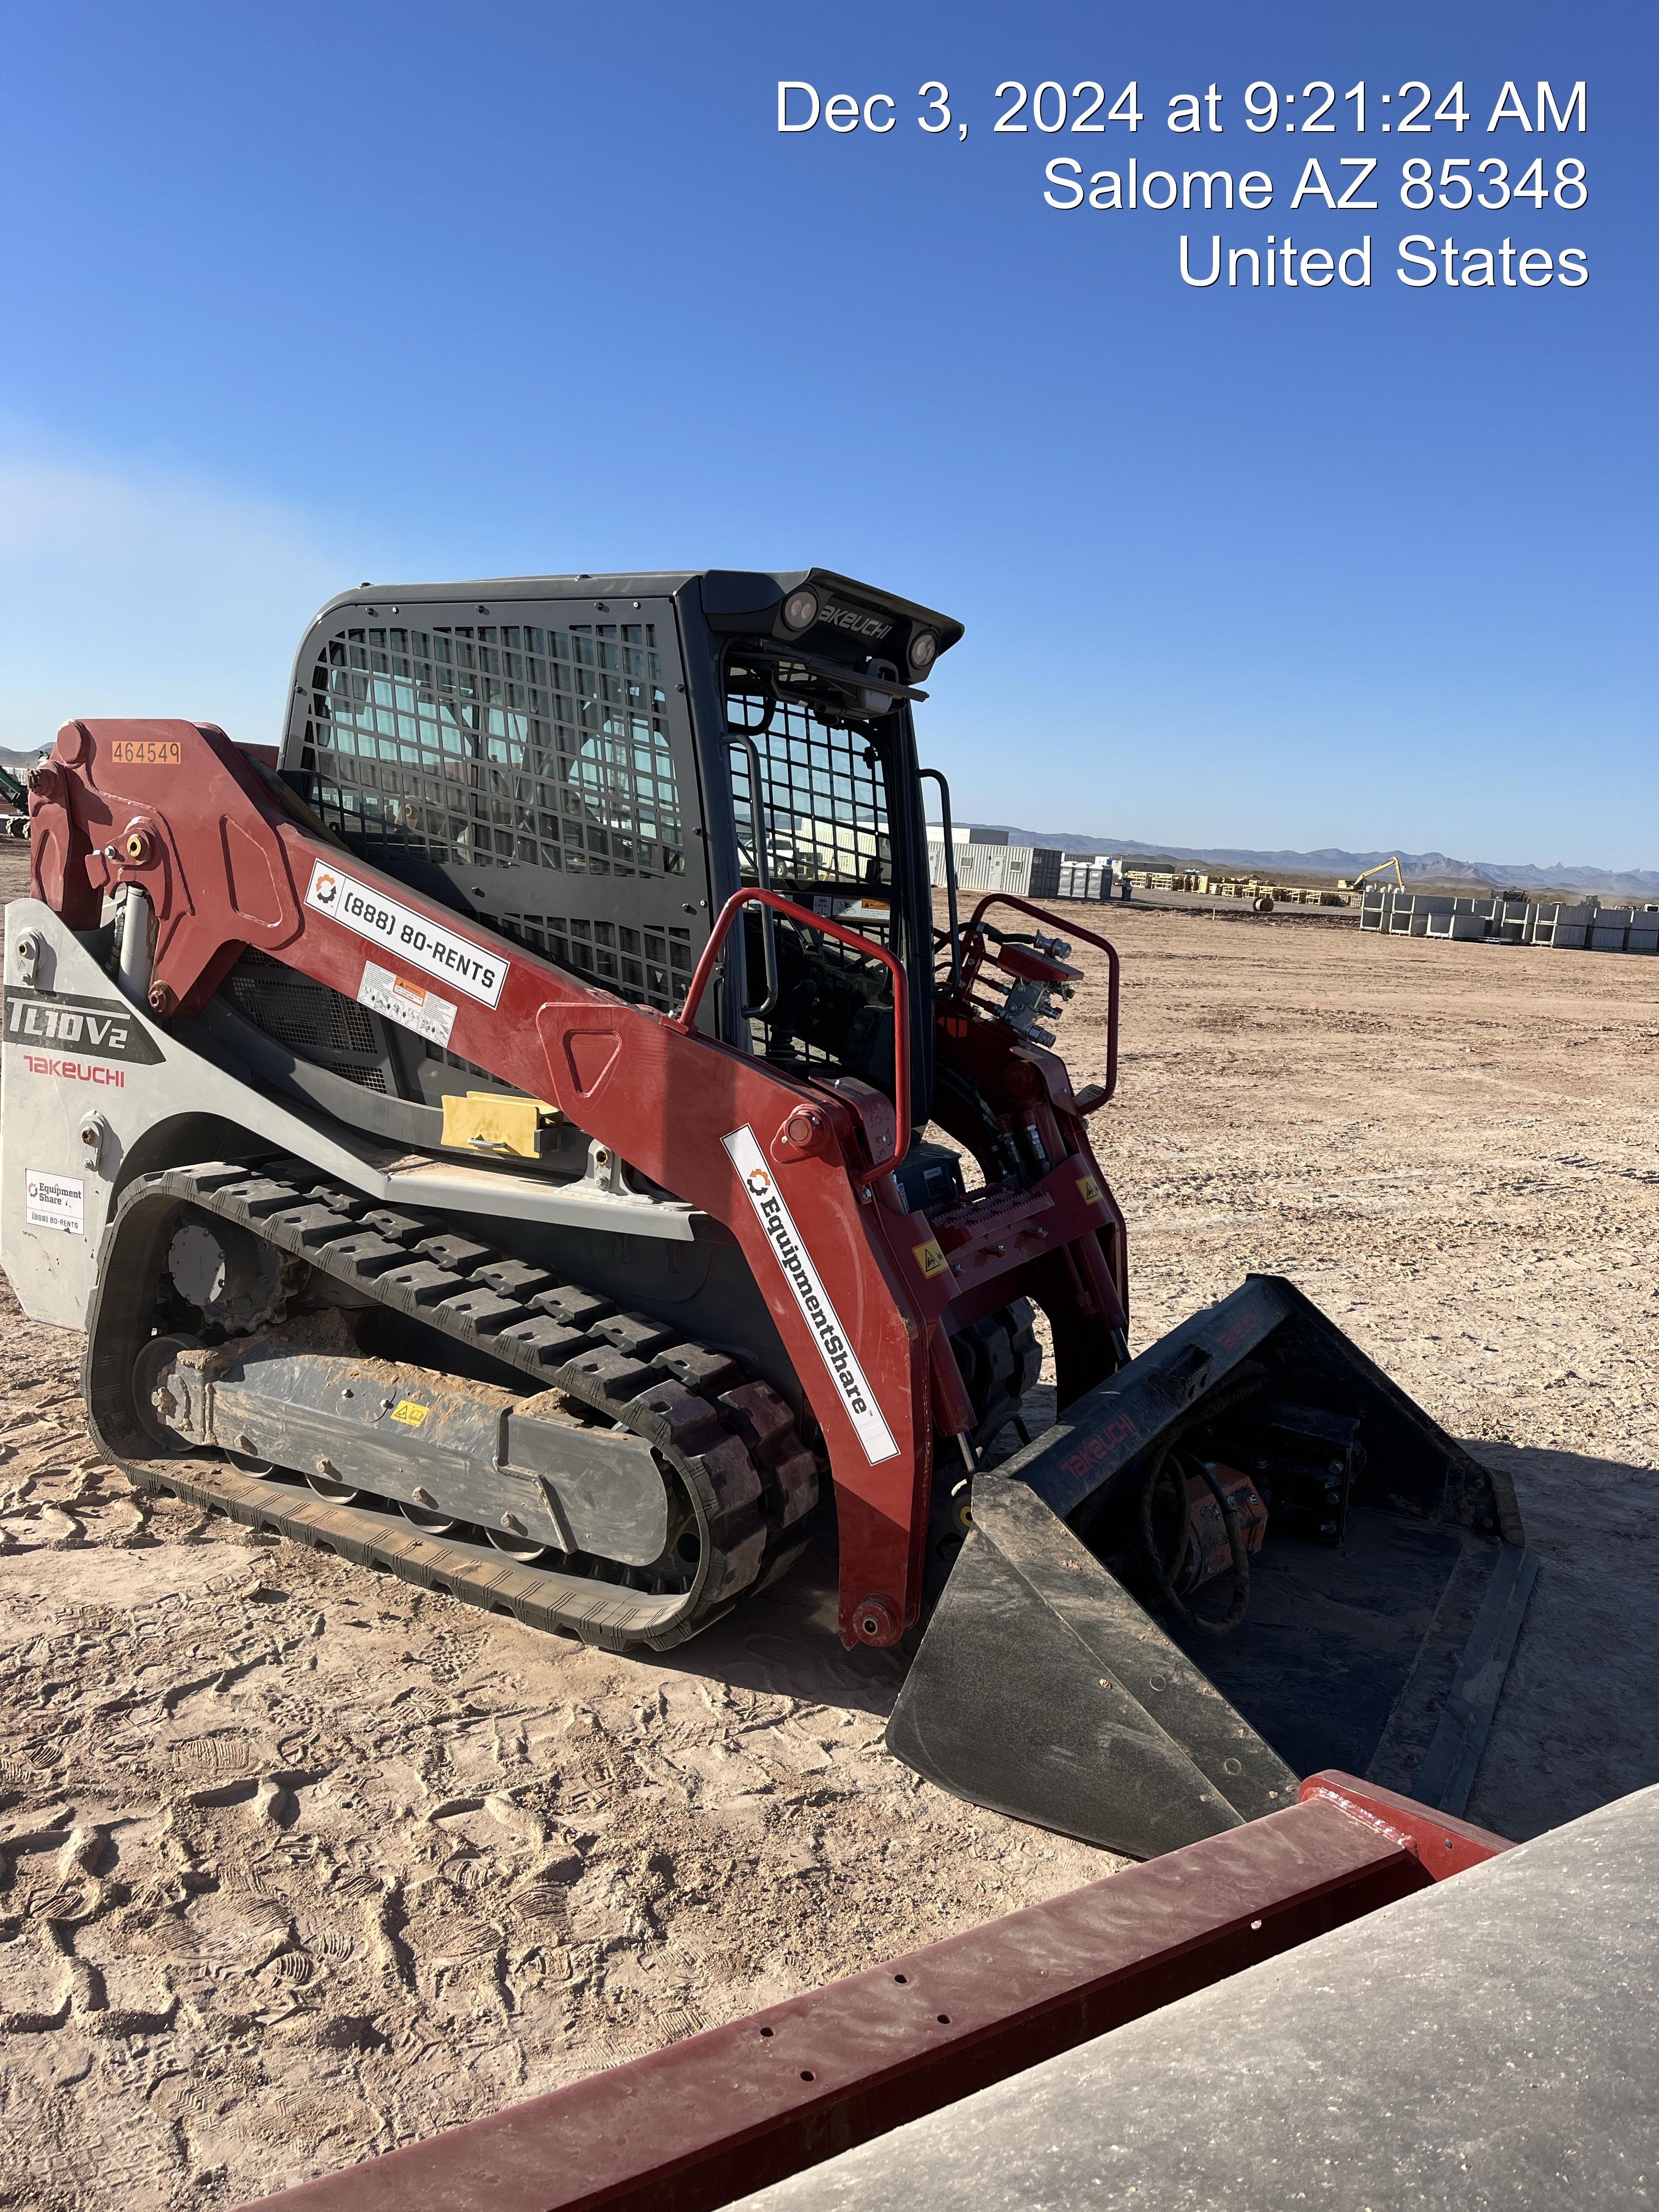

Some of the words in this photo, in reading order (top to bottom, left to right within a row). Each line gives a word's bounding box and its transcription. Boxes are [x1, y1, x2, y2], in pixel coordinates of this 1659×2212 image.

[114, 742, 179, 763] 464549
[345, 892, 395, 935] (888)
[400, 924, 495, 989] 80-RENTS
[7, 997, 130, 1049] TL10V2
[39, 1182, 82, 1199] Equipment
[39, 1193, 62, 1205] Share
[32, 1211, 48, 1223] (888)
[50, 1217, 78, 1229] 80-RENTS
[760, 1195, 867, 1415] EquipmentShare
